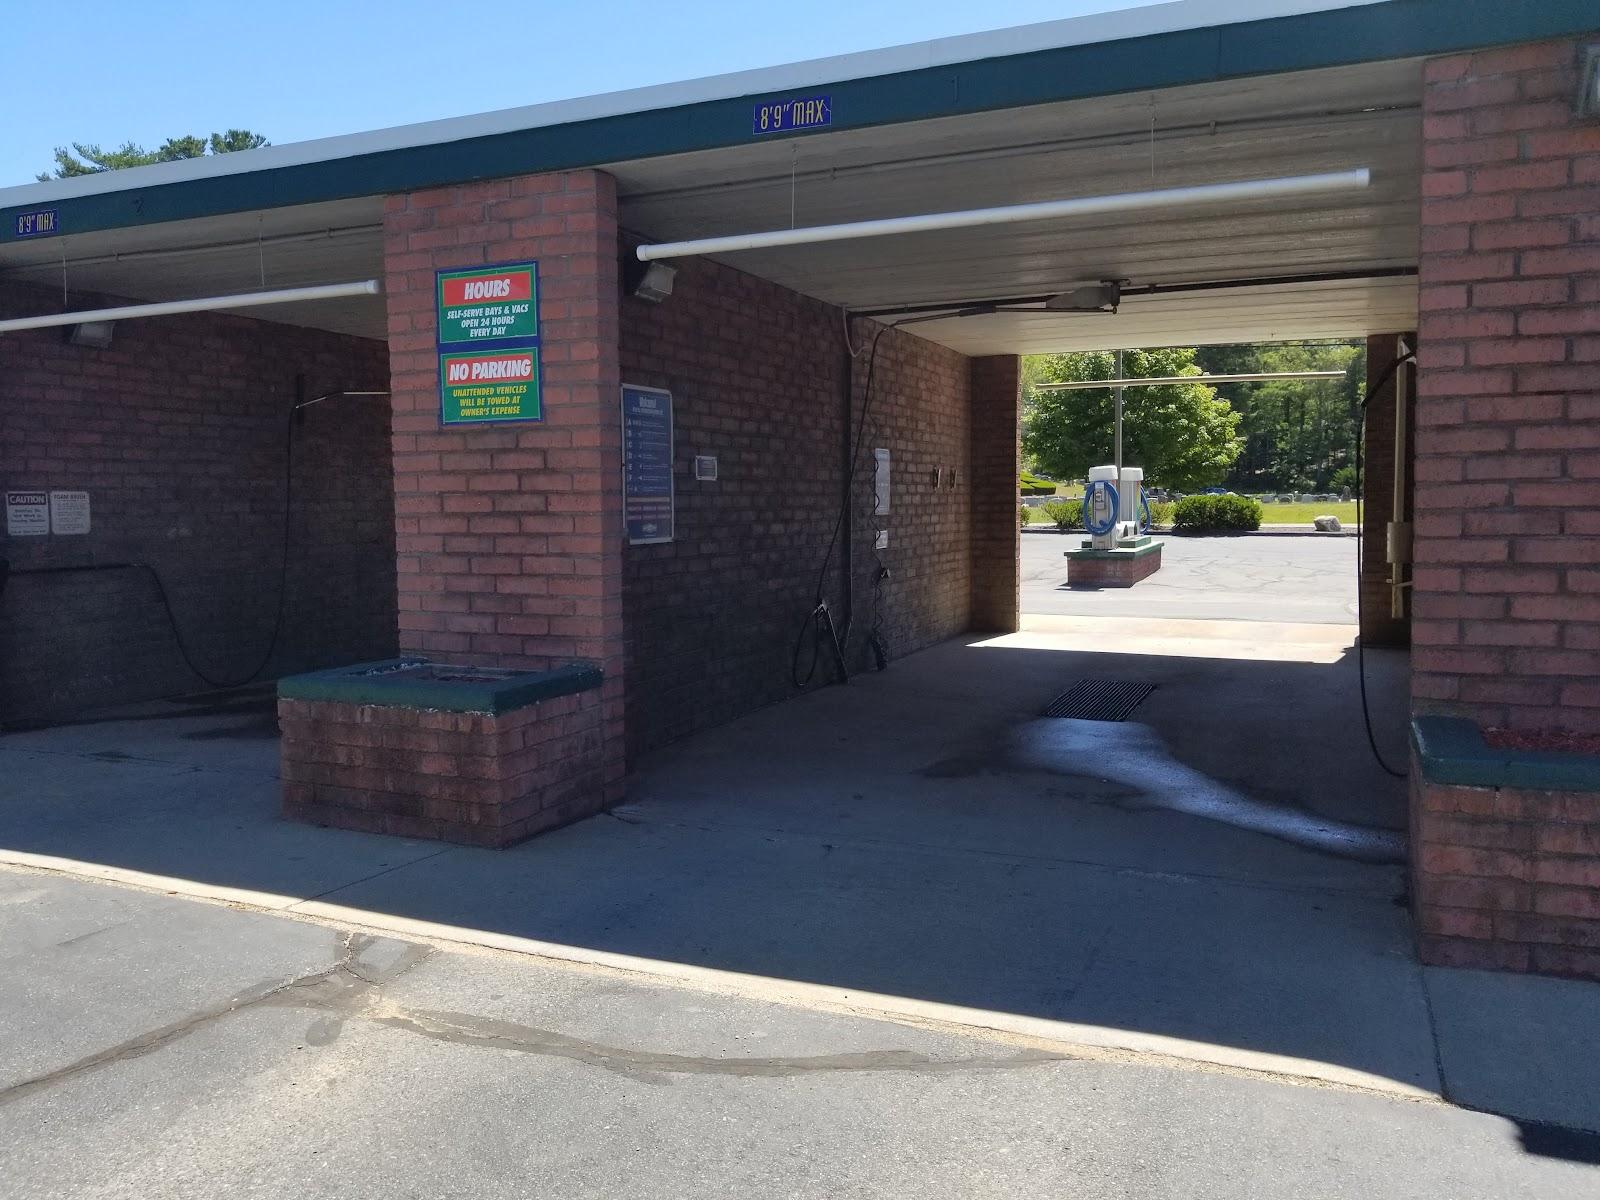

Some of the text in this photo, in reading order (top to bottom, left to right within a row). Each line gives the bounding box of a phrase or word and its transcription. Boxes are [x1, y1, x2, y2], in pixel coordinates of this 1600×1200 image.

[792, 99, 824, 126] MAX
[36, 212, 54, 232] MAX
[464, 279, 511, 300] HOURS
[447, 304, 529, 320] SELF-SERVE BAYS & VACS
[461, 316, 515, 328] OPEN 24 HOURS
[469, 326, 506, 337] EVERY DAY
[449, 359, 532, 381] NO PARKING
[453, 385, 527, 397] UNATTENDED VEHICLES
[460, 396, 521, 406] WILL BE TOWED AT
[460, 405, 521, 417] OWNER'S EXPENSE
[10, 495, 45, 504] CAUTION
